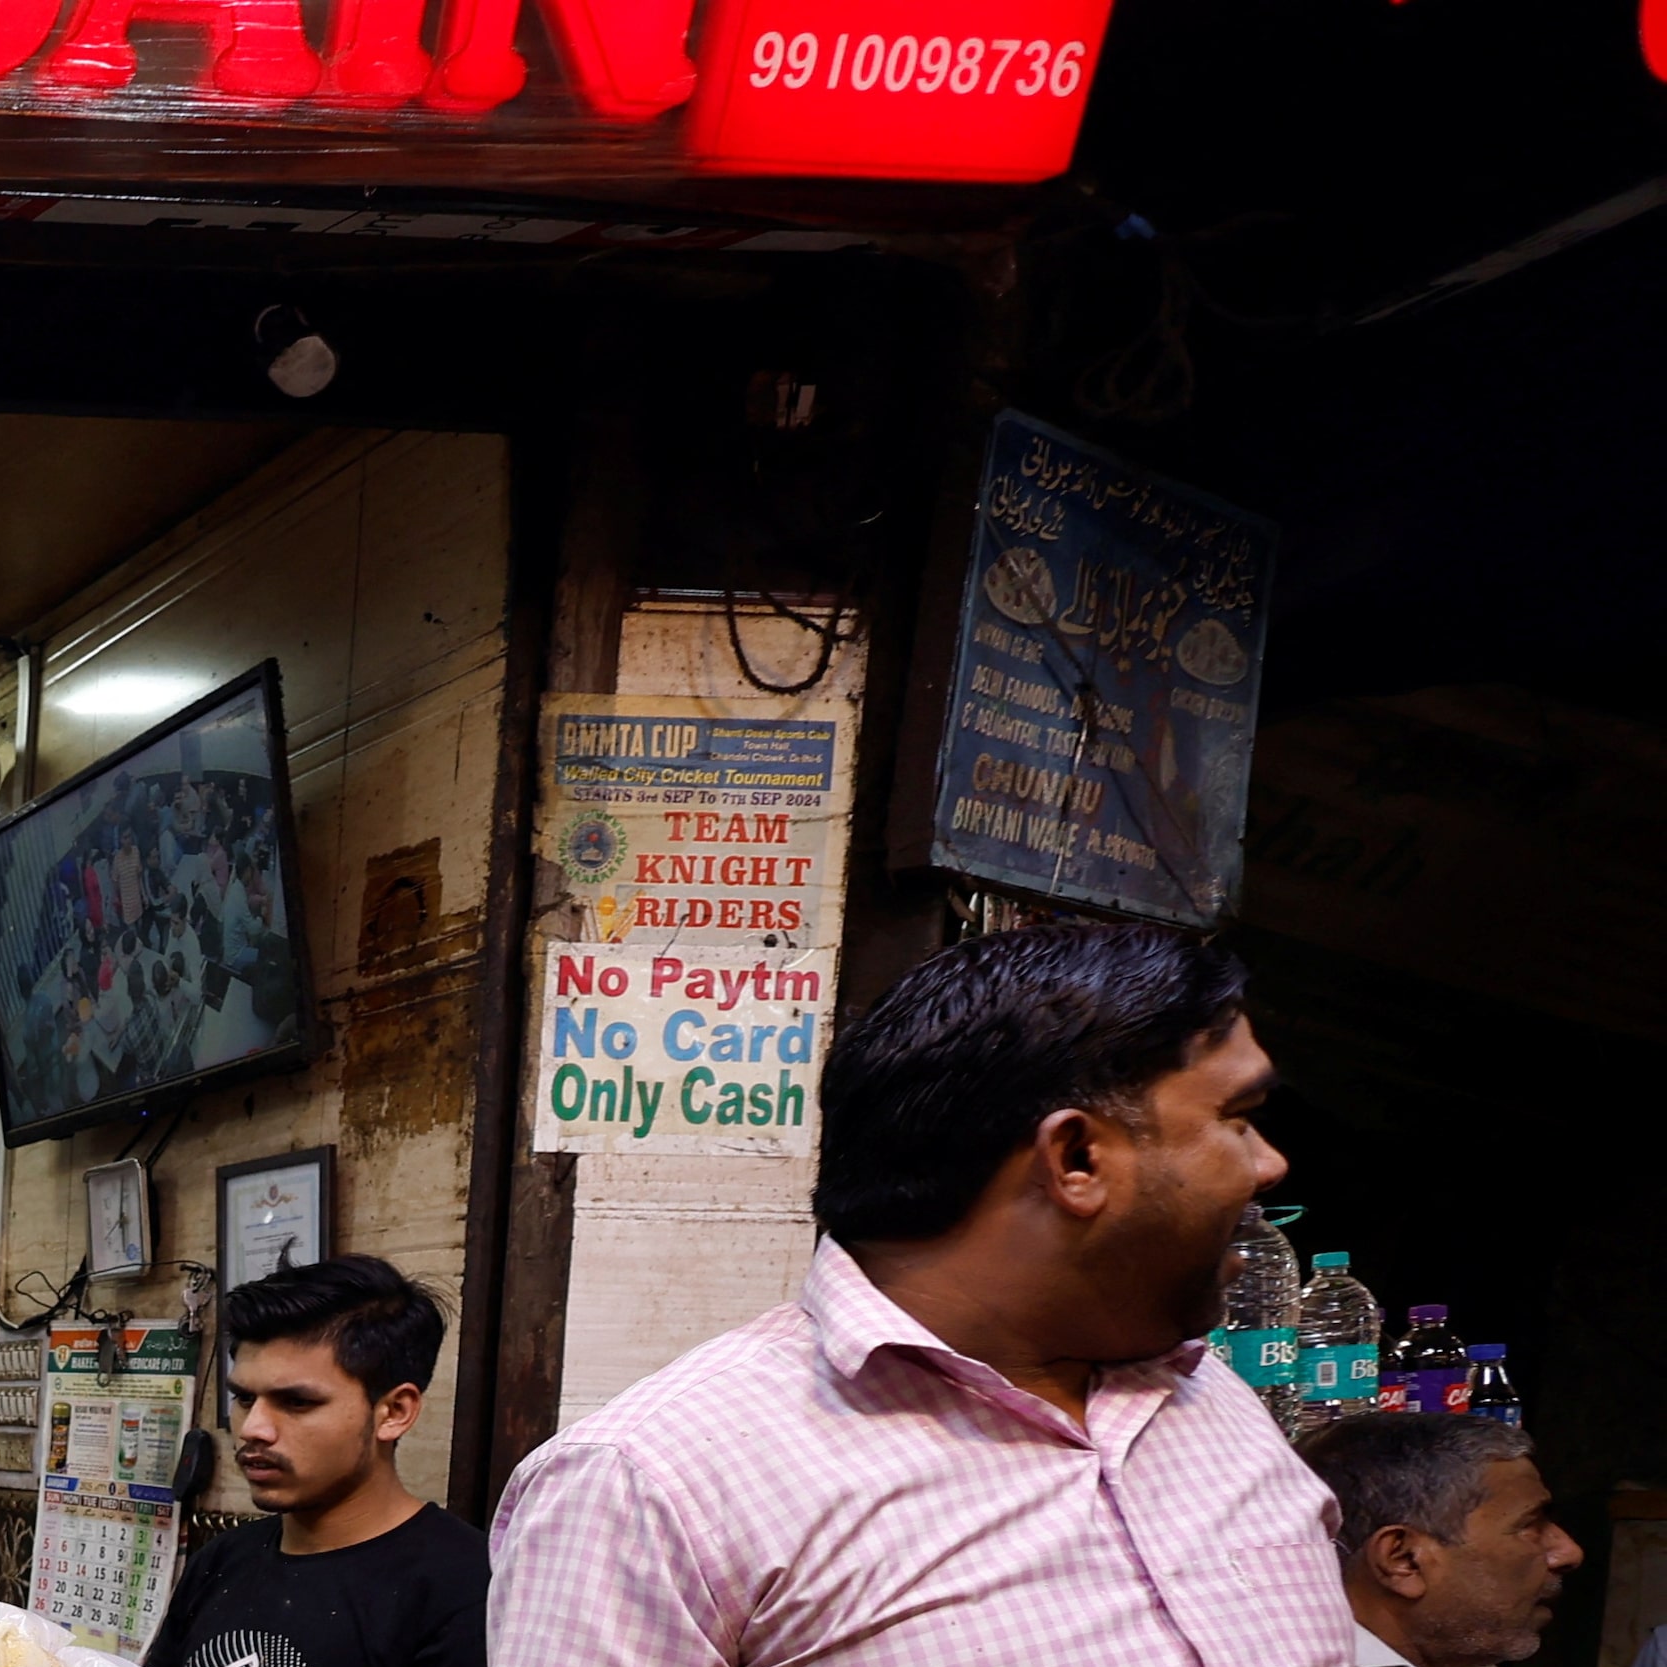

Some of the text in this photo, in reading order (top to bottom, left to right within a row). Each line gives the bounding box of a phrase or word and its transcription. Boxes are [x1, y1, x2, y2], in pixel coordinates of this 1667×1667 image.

[748, 31, 1083, 98] 9910098736
[652, 723, 698, 759] CUP
[562, 765, 824, 787] Walled City Cricket Tournament
[574, 786, 632, 802] STARTS
[637, 792, 658, 803] 3rd
[663, 790, 694, 804] SEP
[697, 791, 717, 805] To
[751, 792, 783, 806] SEP
[786, 793, 821, 807] 2024
[663, 811, 790, 844] TEAM
[951, 796, 1024, 843] BIRYANI
[634, 854, 812, 887] KNIGHT
[634, 897, 802, 931] RIDERS
[556, 955, 820, 1011] No Paytm
[553, 1007, 815, 1064] No Card
[551, 1063, 805, 1139] Only Cash
[45, 1491, 61, 1502] SUN
[63, 1493, 80, 1505] MON
[82, 1495, 99, 1508] TUE
[101, 1498, 118, 1510] WED
[39, 1558, 157, 1590] 12 13 14 15 16 17 18
[133, 1552, 145, 1566] 10
[150, 1555, 160, 1569] 11
[37, 1578, 154, 1612] 19 20 21 22 23 24 25
[35, 1597, 134, 1631] 26 27 28 29 30 31
